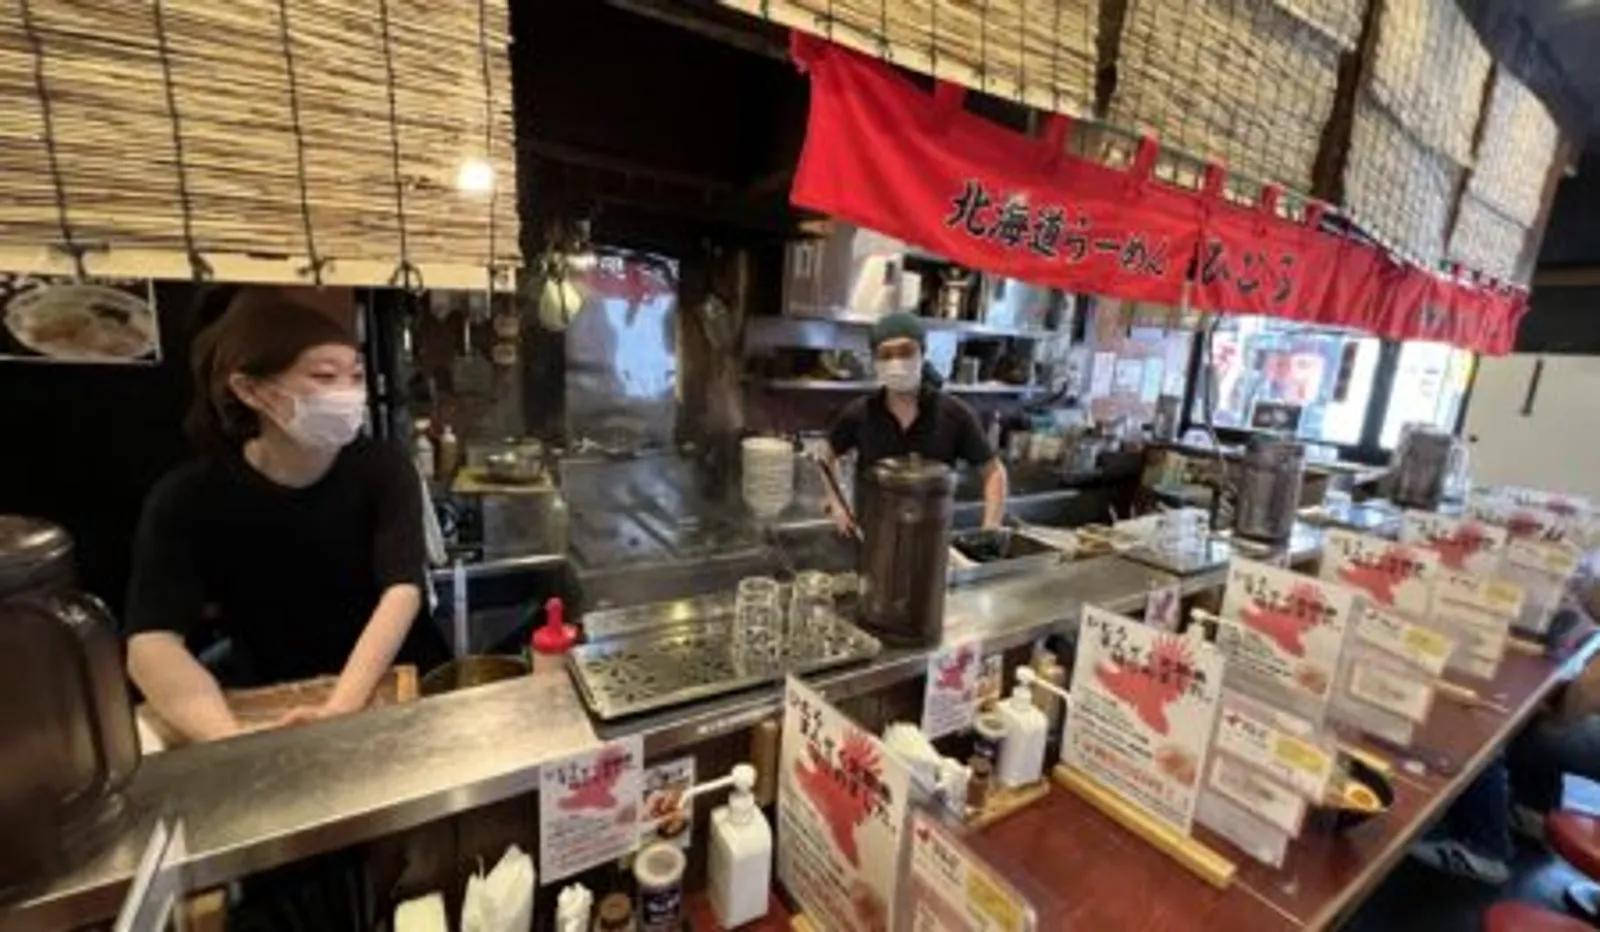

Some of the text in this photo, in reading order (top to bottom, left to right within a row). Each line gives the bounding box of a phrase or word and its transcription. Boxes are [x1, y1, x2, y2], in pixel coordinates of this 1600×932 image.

[947, 180, 1166, 275] 北海道らーめん
